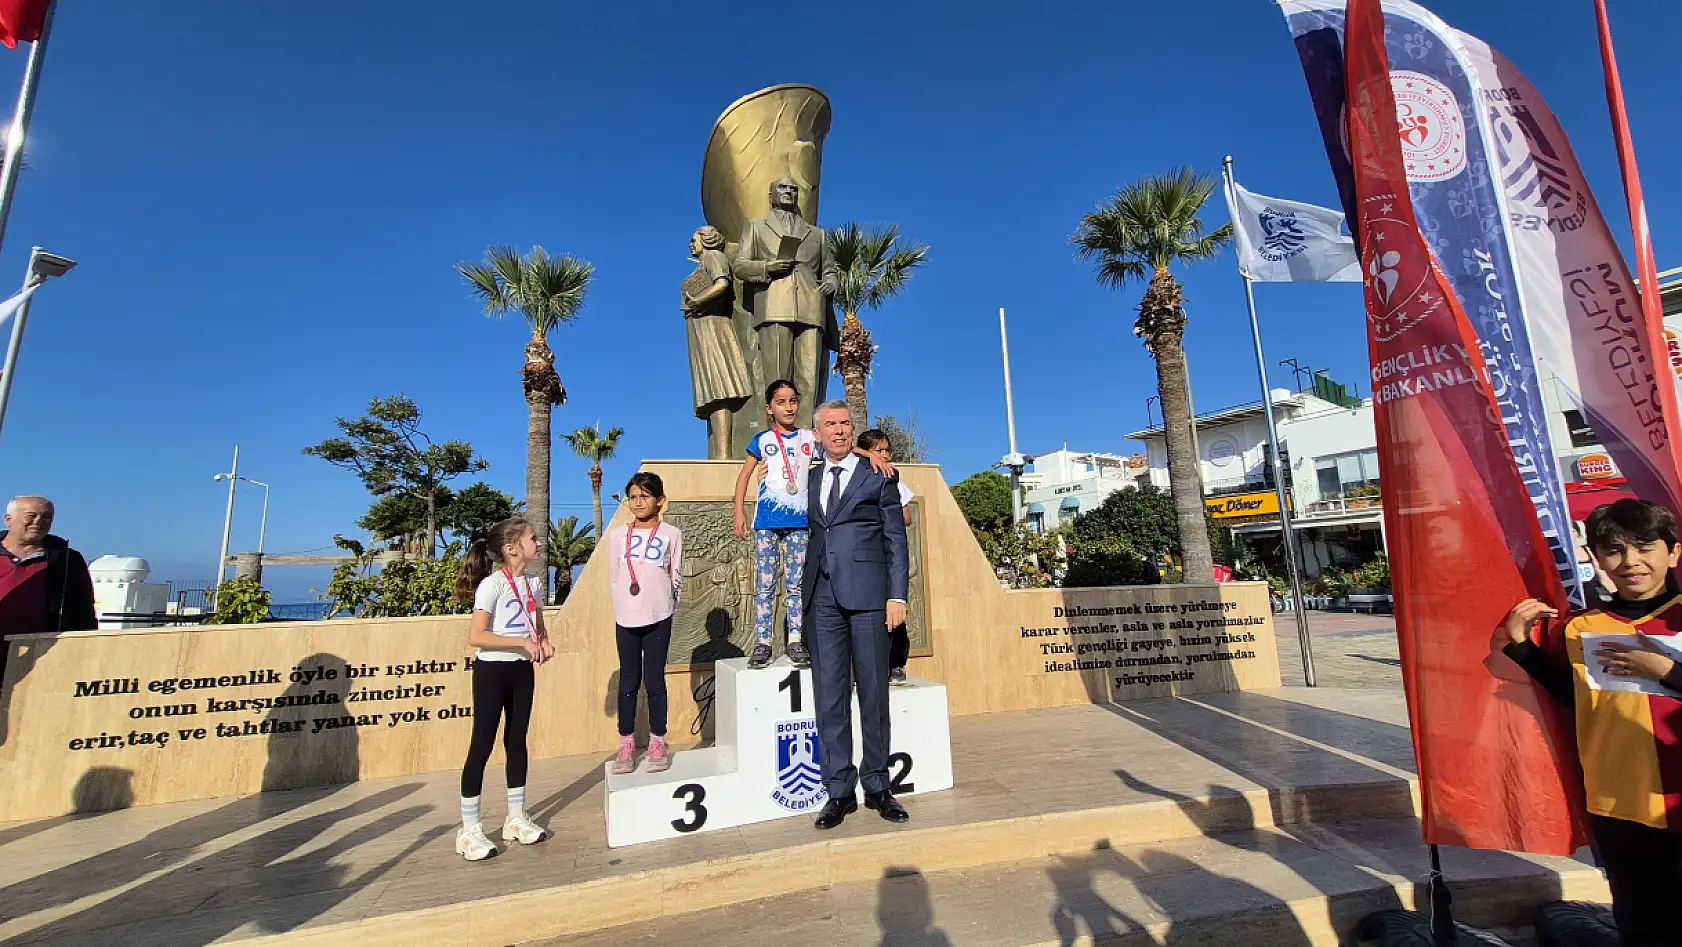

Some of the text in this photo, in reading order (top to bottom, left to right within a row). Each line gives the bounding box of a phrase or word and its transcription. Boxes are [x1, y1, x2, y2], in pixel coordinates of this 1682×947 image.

[1372, 344, 1454, 381] GENÇLİK
[1580, 464, 1612, 474] KING
[1226, 498, 1263, 512] Döner
[624, 535, 663, 560] 28
[504, 599, 525, 628] 2
[1053, 600, 1237, 618] Dinlenmemek üzere yürümeye
[1021, 615, 1265, 638] karar verenler, asla ve asla yorulmazlar
[1040, 642, 1074, 655] Türk
[1077, 638, 1128, 655] gençliği
[1131, 638, 1176, 652] gayeye,
[1215, 632, 1256, 646] yüksek
[1044, 649, 1256, 673] idealimize durmadan, yorulmadan
[73, 677, 139, 697] Milli
[148, 669, 282, 694] egemenlik
[289, 666, 337, 685] öyle
[344, 664, 379, 679] bir
[386, 660, 457, 678] ışıktır
[779, 669, 801, 713] 1
[1115, 670, 1195, 688] yürüyecektir
[129, 683, 445, 719] onun karşısında zincirler
[178, 727, 207, 741] ve
[216, 718, 306, 738] tahtlar
[312, 713, 383, 733] yanar
[388, 707, 430, 727] yok
[438, 704, 474, 719] olu
[777, 721, 817, 733] BODRU
[888, 752, 915, 795] 2
[671, 783, 708, 832] 3
